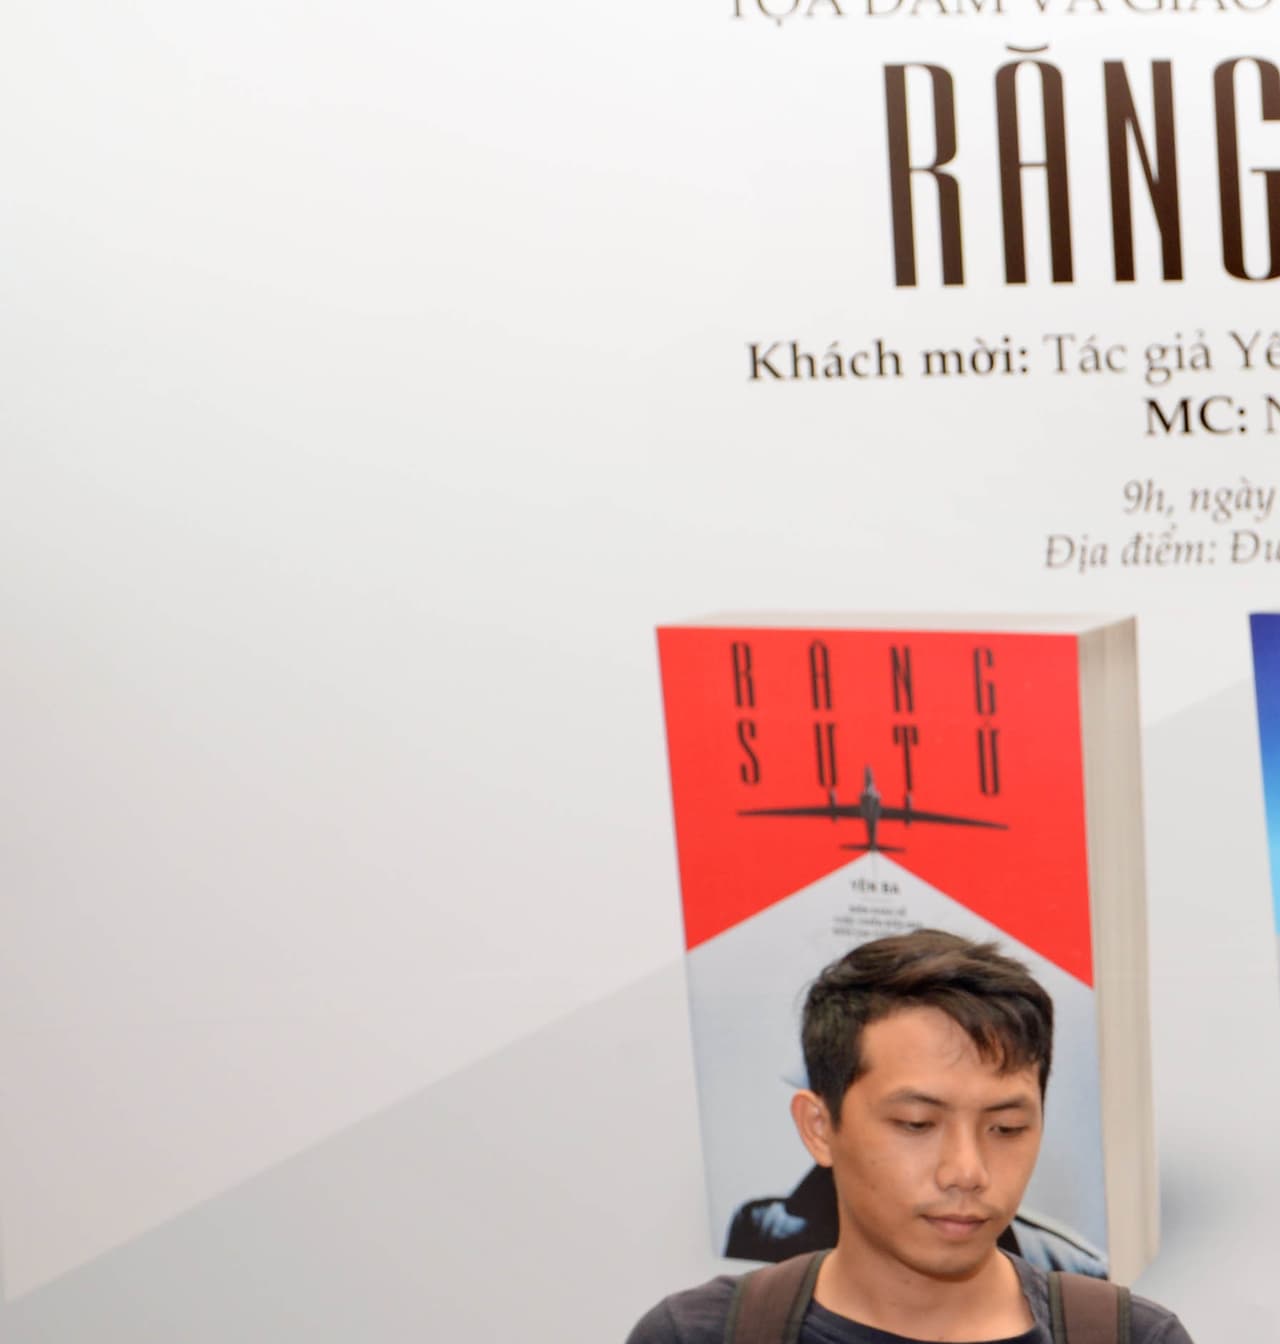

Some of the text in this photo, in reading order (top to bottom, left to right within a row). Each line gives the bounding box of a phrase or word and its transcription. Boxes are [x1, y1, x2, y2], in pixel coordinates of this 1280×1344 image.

[748, 338, 904, 382] Khách
[922, 335, 1029, 377] mời:
[1043, 334, 1126, 374] Tác
[1144, 331, 1213, 383] giả
[1144, 398, 1248, 437] MC:
[1122, 478, 1176, 517] 9h,
[1189, 476, 1277, 523] ngày
[1045, 533, 1110, 575] Địa
[1120, 522, 1217, 568] điểm:
